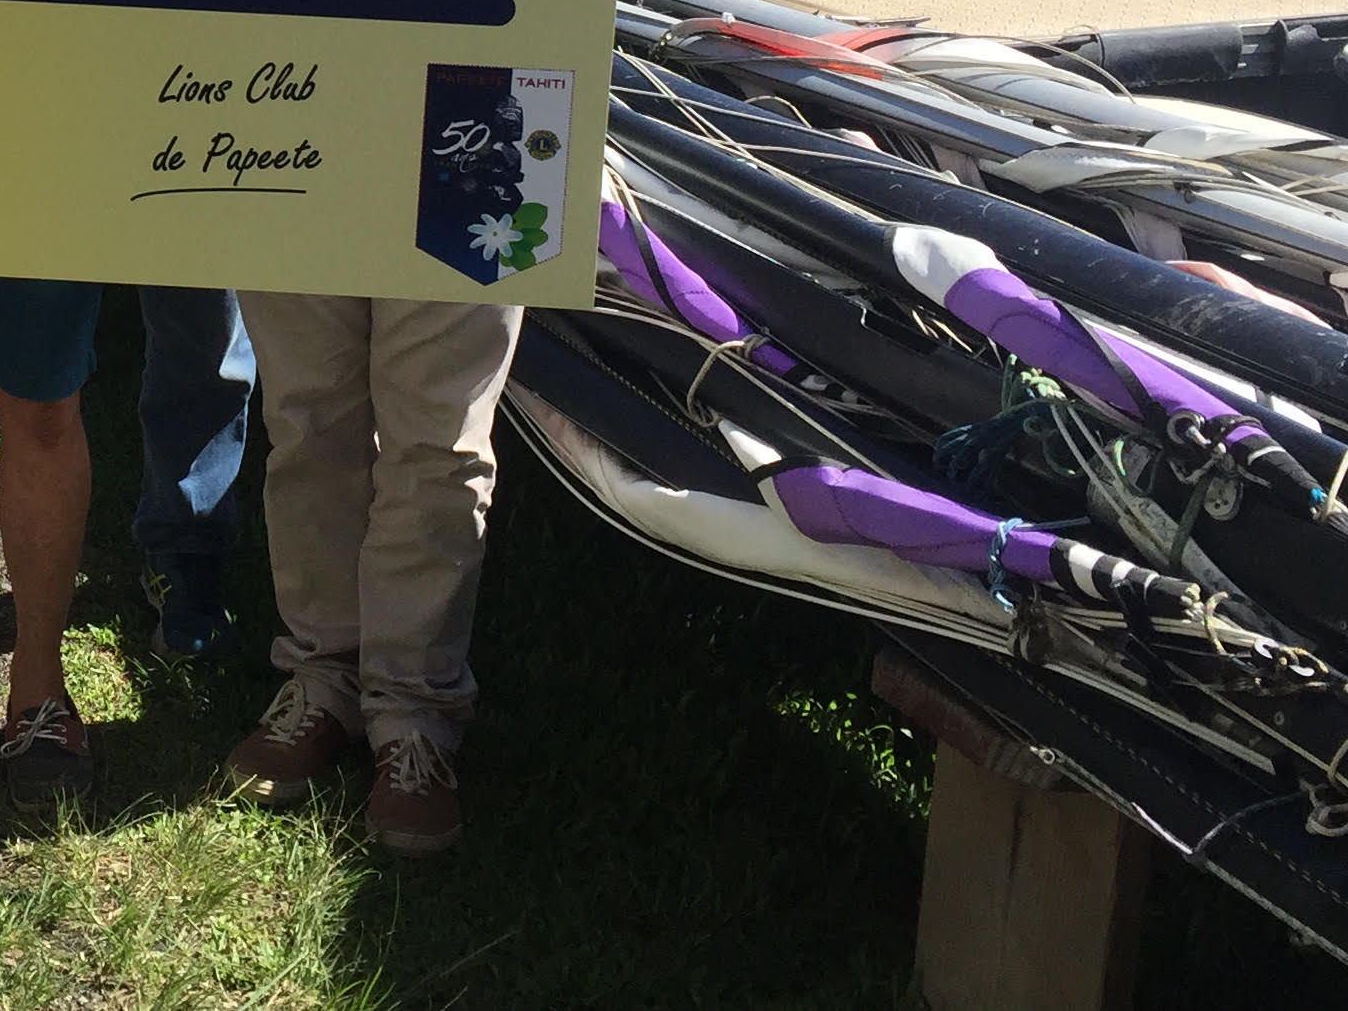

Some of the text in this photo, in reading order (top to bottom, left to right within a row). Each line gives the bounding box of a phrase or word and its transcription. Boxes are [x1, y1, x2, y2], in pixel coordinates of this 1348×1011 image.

[158, 62, 318, 105] Lions Club
[516, 77, 566, 89] TAHITI
[432, 120, 491, 155] 50
[153, 132, 323, 186] de Papeete
